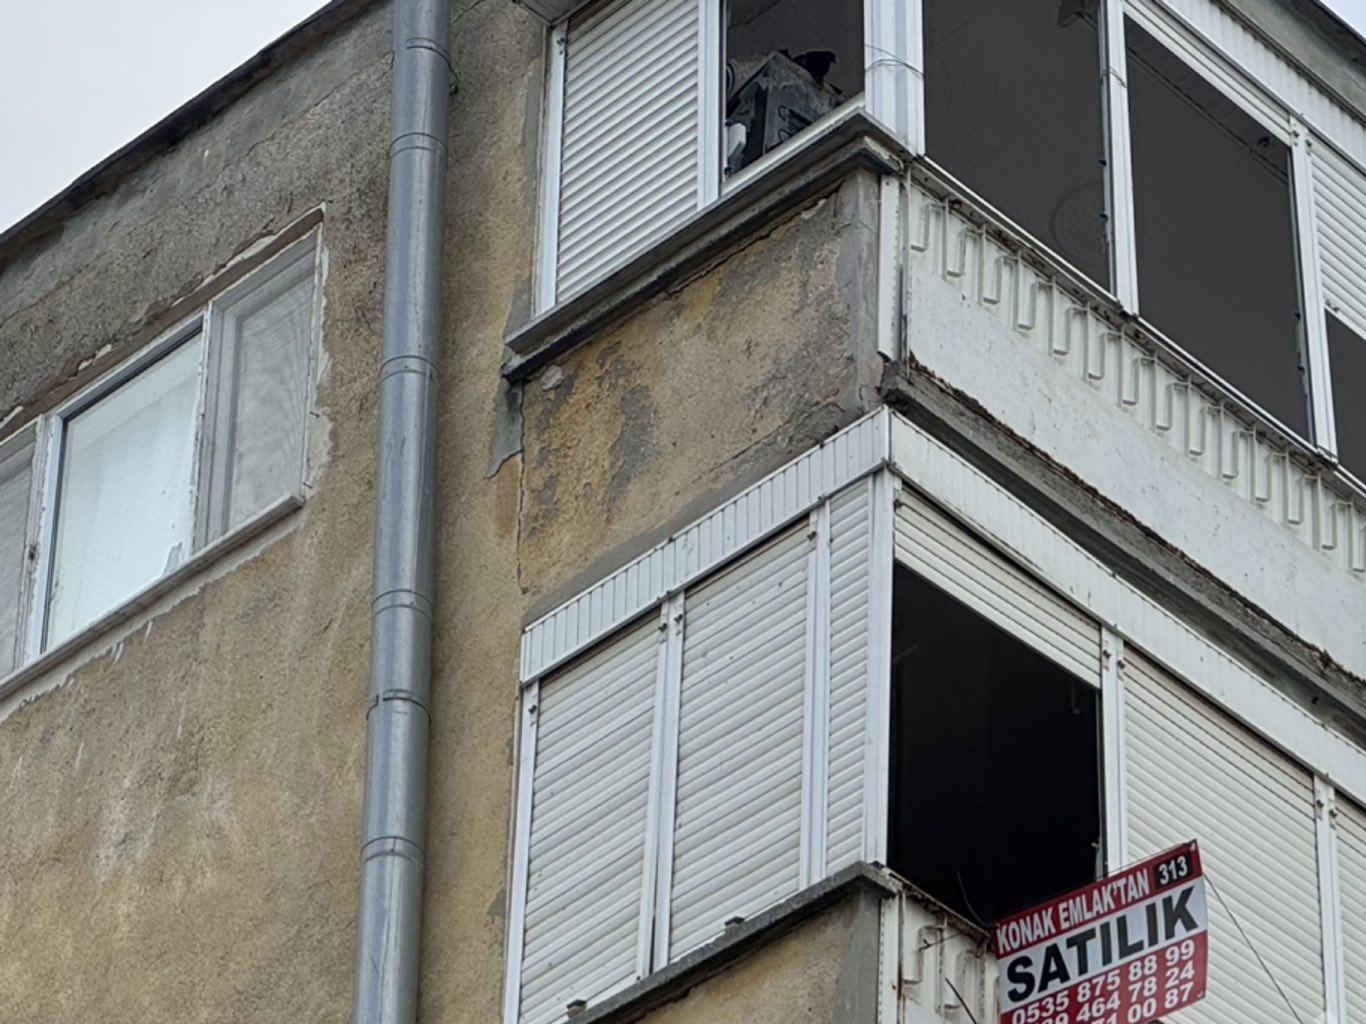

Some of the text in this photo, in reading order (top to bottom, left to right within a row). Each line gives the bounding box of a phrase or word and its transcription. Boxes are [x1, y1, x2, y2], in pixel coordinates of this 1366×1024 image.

[996, 855, 1188, 955] KONAK EMLAK'TAN 313
[1006, 885, 1199, 1003] SATILIK
[1077, 969, 1120, 1003] 875
[1128, 954, 1157, 982] 88
[1165, 939, 1195, 967] 99
[1076, 991, 1120, 1023] 464
[1128, 976, 1157, 1003] 78
[1165, 960, 1195, 989] 24
[1127, 998, 1157, 1024] 00
[1164, 981, 1194, 1009] 87
